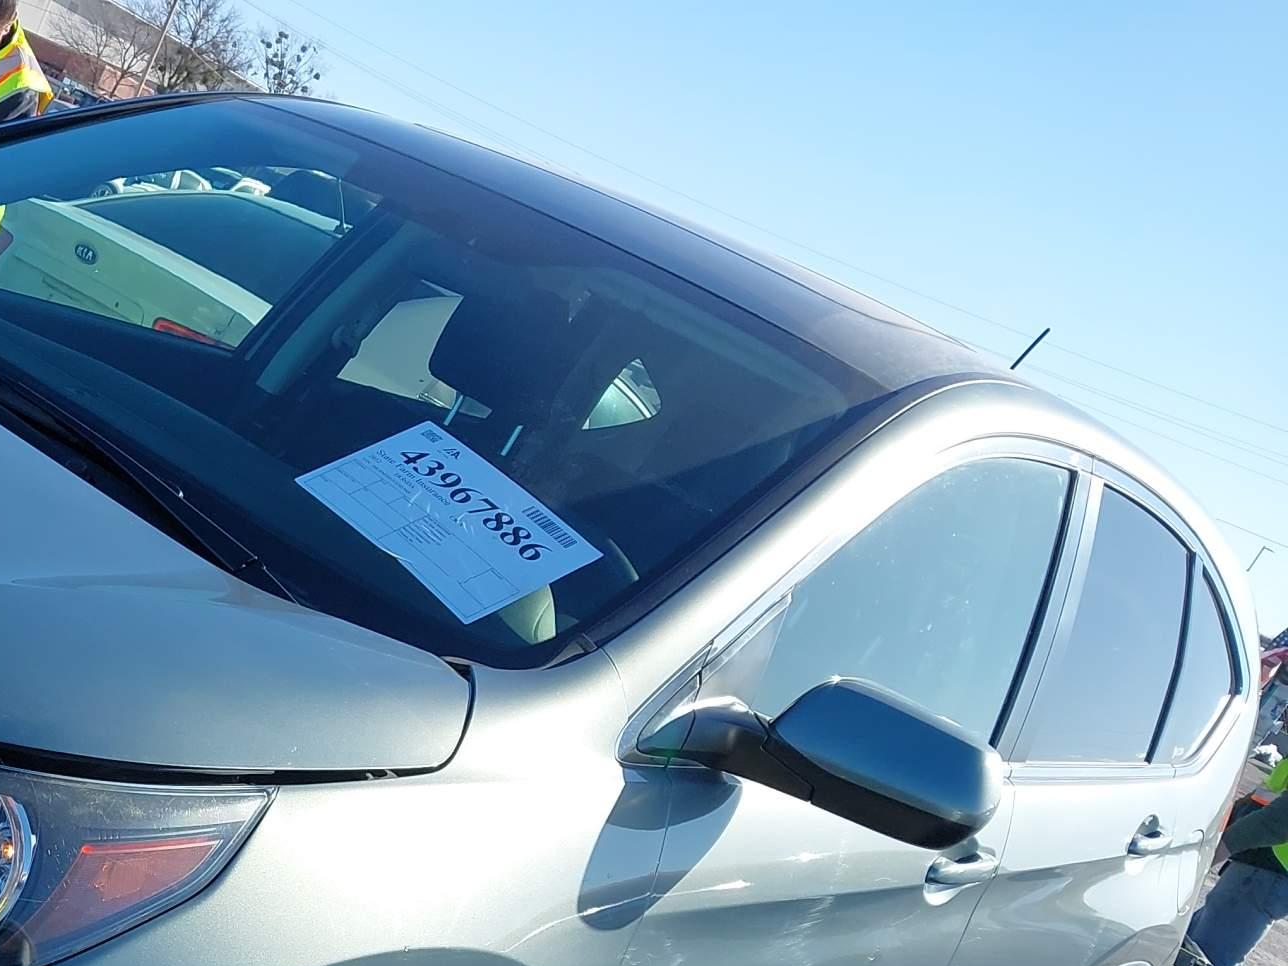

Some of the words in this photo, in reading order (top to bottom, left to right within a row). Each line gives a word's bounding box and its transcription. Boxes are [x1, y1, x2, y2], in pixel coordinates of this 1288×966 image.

[76, 246, 94, 261] KIA
[376, 449, 396, 465] State
[395, 463, 416, 480] Farm
[415, 478, 451, 506] Insurance
[400, 451, 553, 561] 43967886
